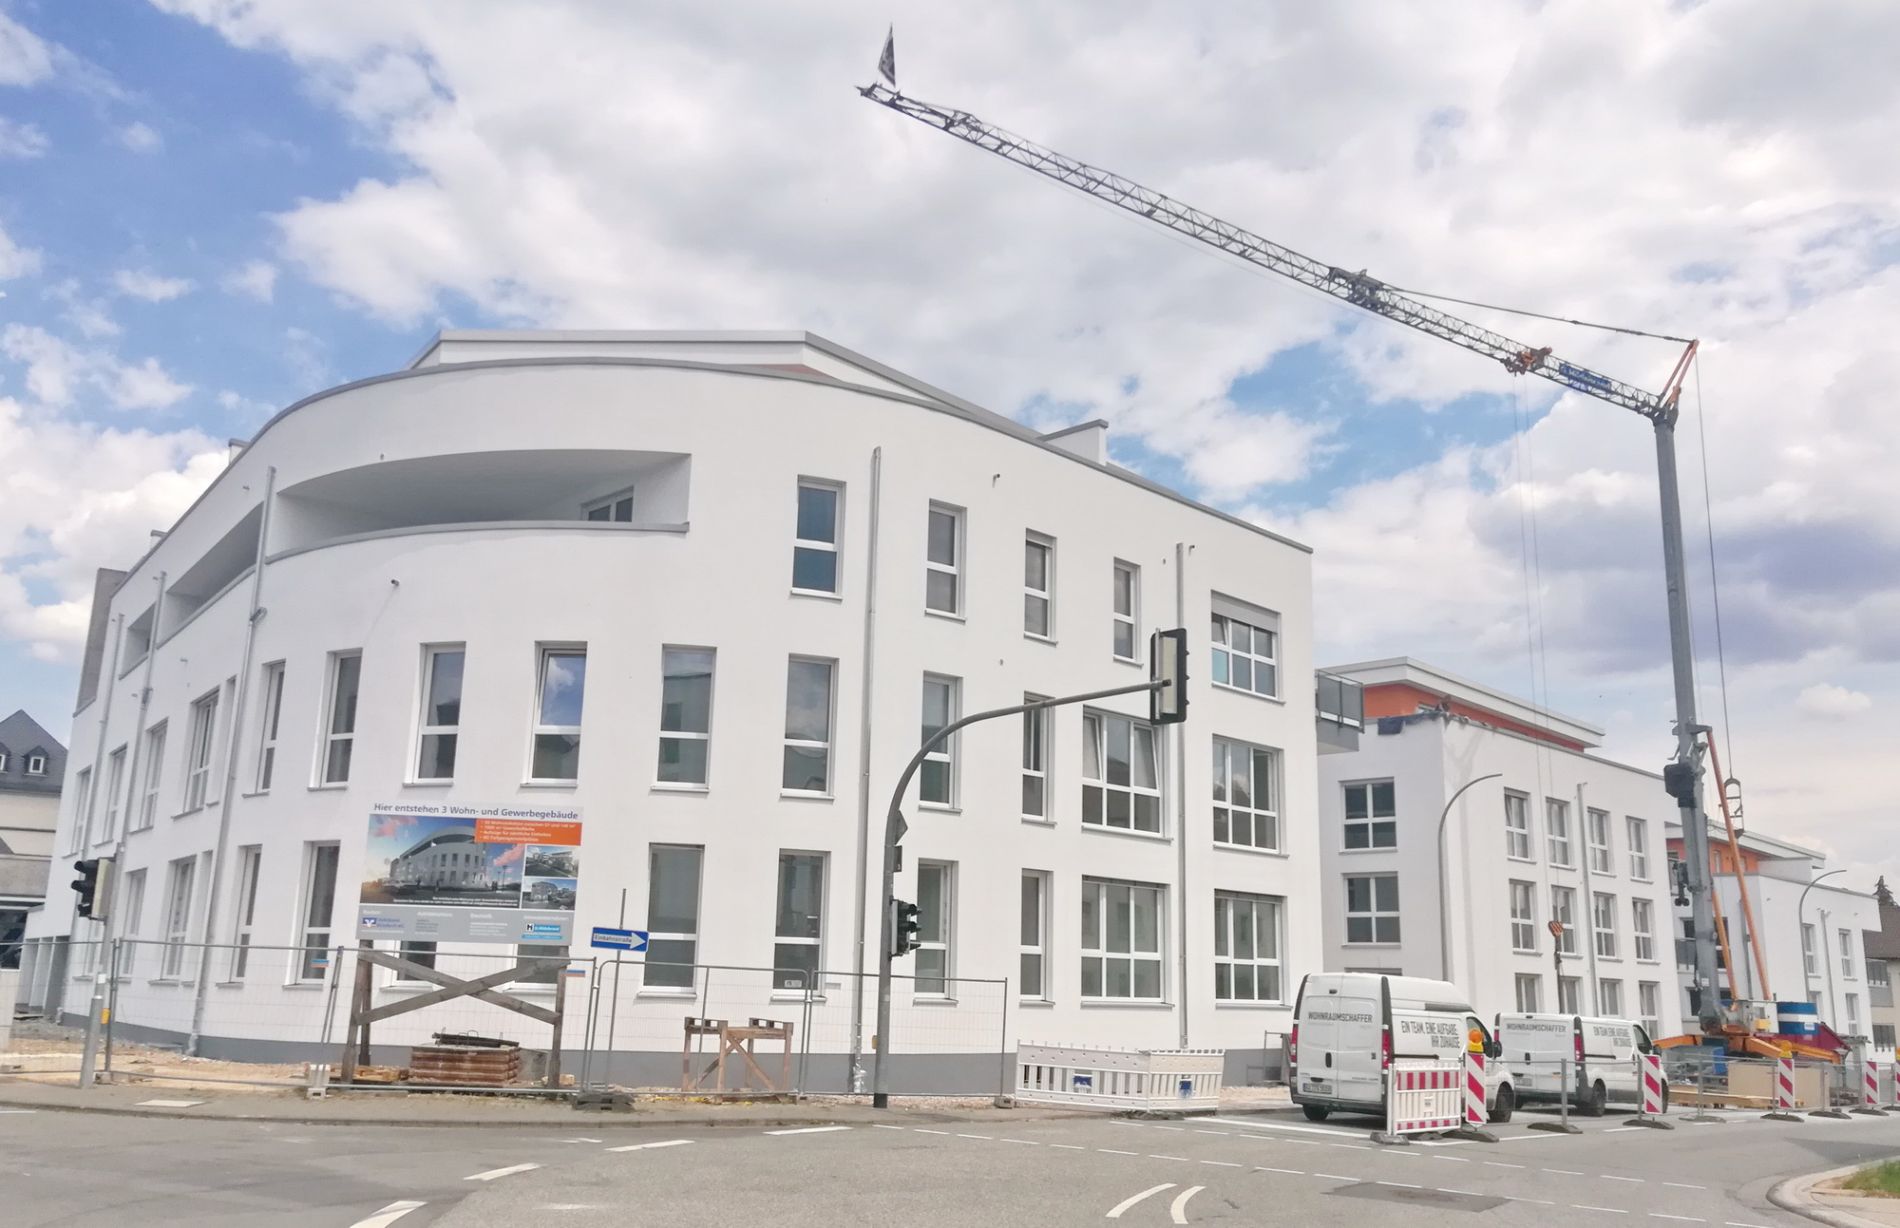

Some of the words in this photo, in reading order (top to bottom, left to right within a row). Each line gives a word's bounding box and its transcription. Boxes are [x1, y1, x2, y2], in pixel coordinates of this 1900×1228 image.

[374, 803, 393, 812] Hier
[394, 804, 439, 814] entstehen
[441, 805, 447, 814] 3
[449, 806, 479, 815] Wohn-
[481, 807, 499, 816] und
[501, 808, 578, 820] Gewerbegebäude
[1308, 1011, 1373, 1023] WOHNRAUMSCHAFFER
